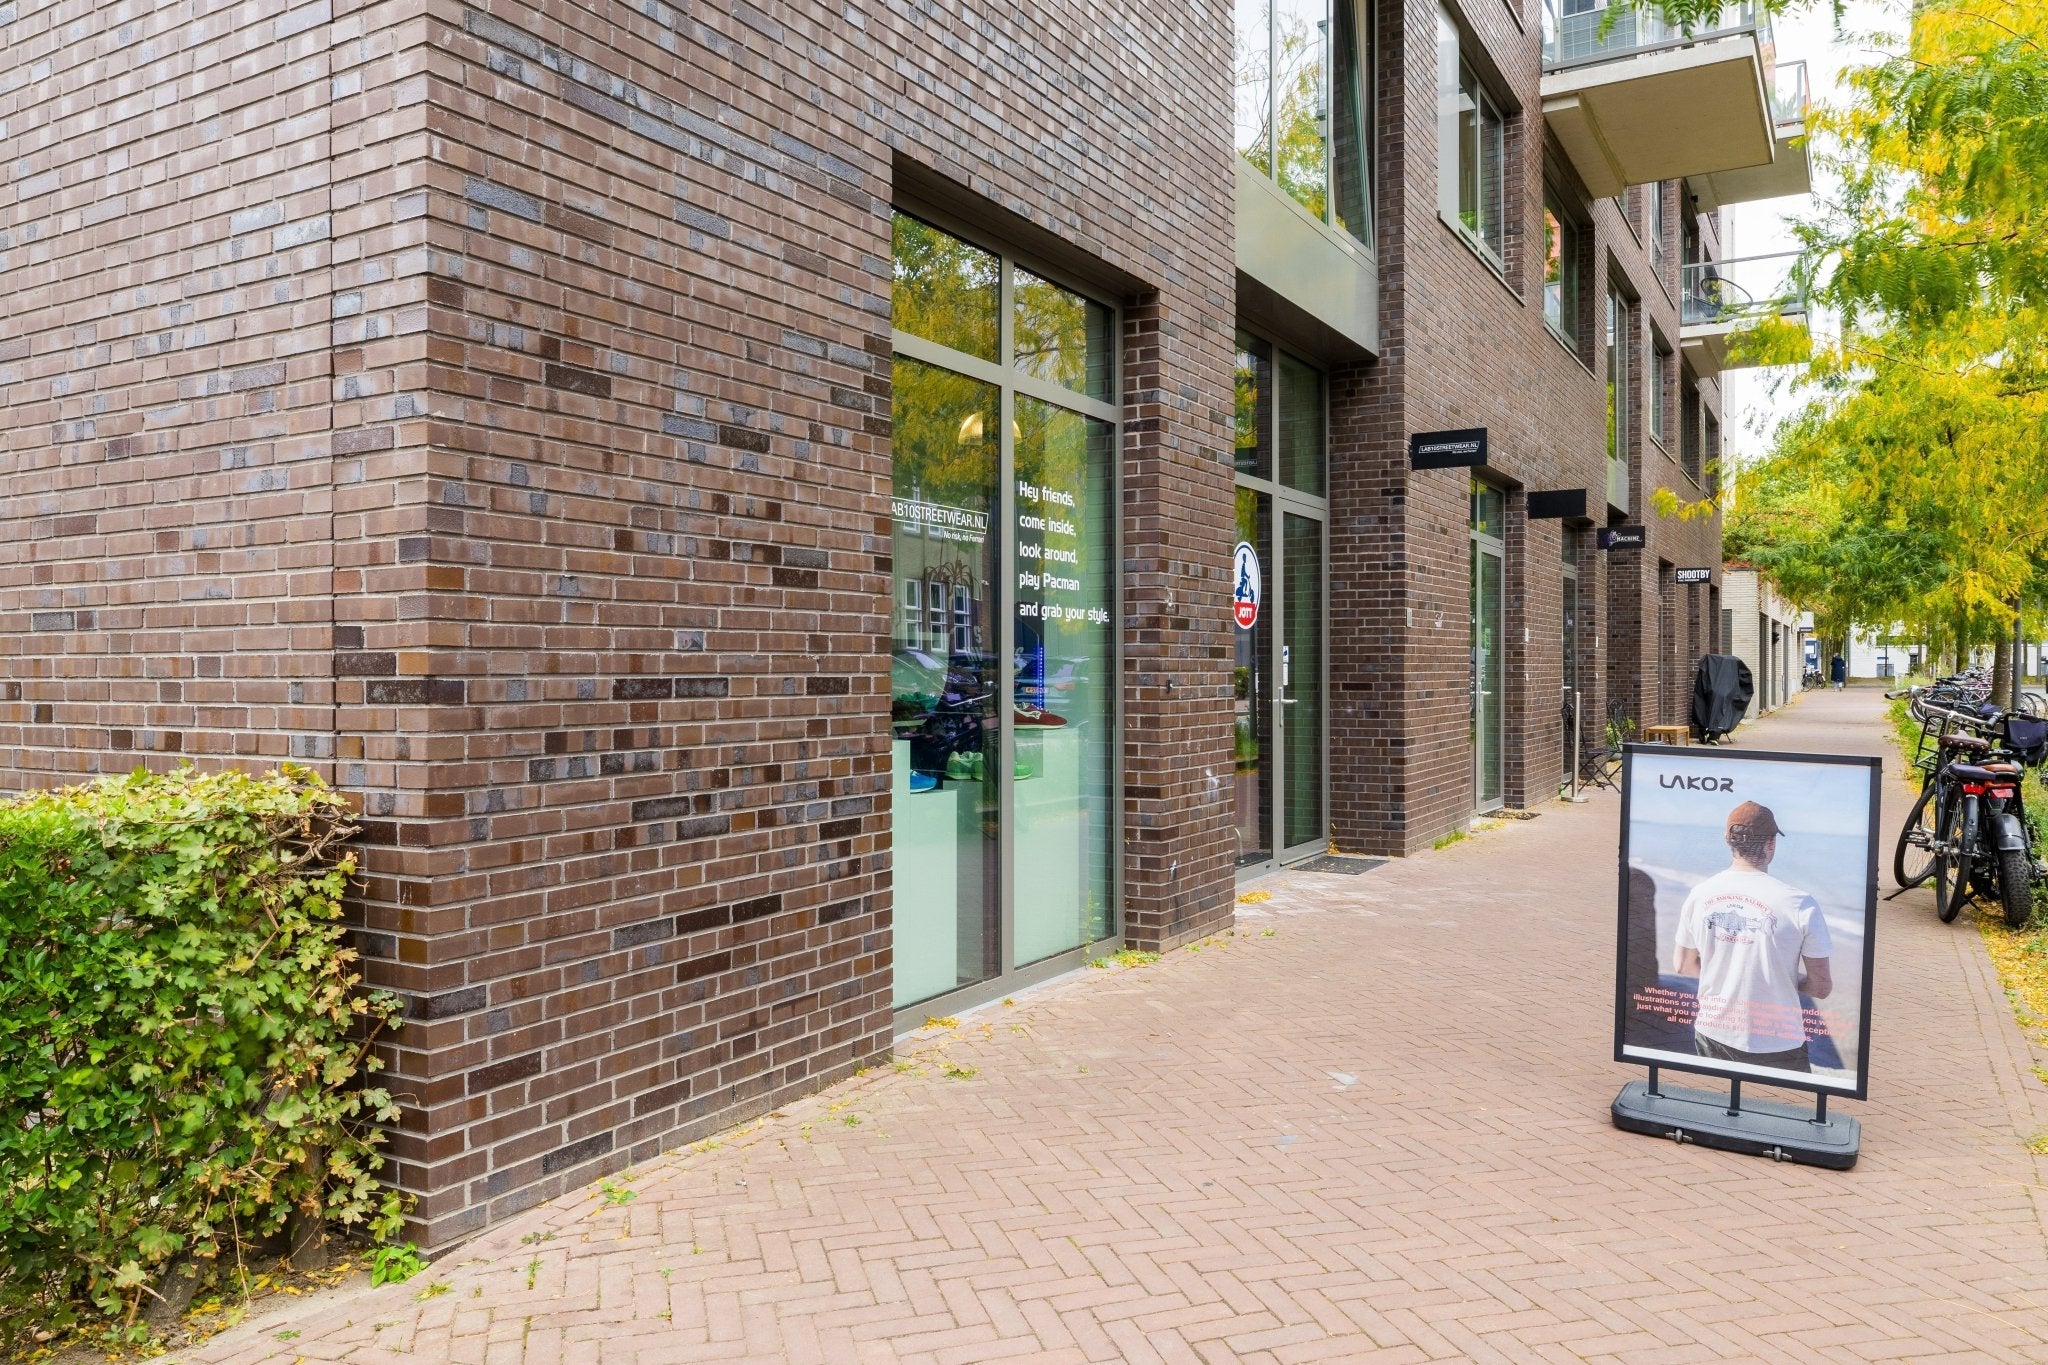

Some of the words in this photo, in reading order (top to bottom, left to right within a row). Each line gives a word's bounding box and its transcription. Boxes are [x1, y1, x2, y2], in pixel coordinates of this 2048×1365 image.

[1019, 480, 1039, 503] Hey
[1041, 485, 1075, 508] friends,
[890, 501, 987, 530] AB10STREETWEAR.NL
[943, 530, 951, 539] No
[1019, 515, 1045, 530] come
[1048, 516, 1077, 538] inside,
[1019, 541, 1041, 558] look
[1044, 549, 1078, 566] around,
[1019, 571, 1040, 590] play
[1043, 572, 1079, 591] Pacman
[1677, 569, 1710, 579] SHOOTBY
[1019, 601, 1038, 617] and
[1041, 604, 1062, 621] grab
[1065, 607, 1085, 622] your
[1087, 606, 1109, 624] style.
[1238, 606, 1253, 618] JOTT
[1659, 774, 1734, 793] LAKOR
[1633, 993, 1679, 1006] illustrations
[1644, 986, 1678, 997] Whether
[1678, 992, 1695, 1000] you
[1636, 1002, 1652, 1011] just
[1652, 1004, 1673, 1013] what
[1673, 1007, 1689, 1016] you
[1667, 1015, 1677, 1023] all
[1678, 1017, 1692, 1025] our
